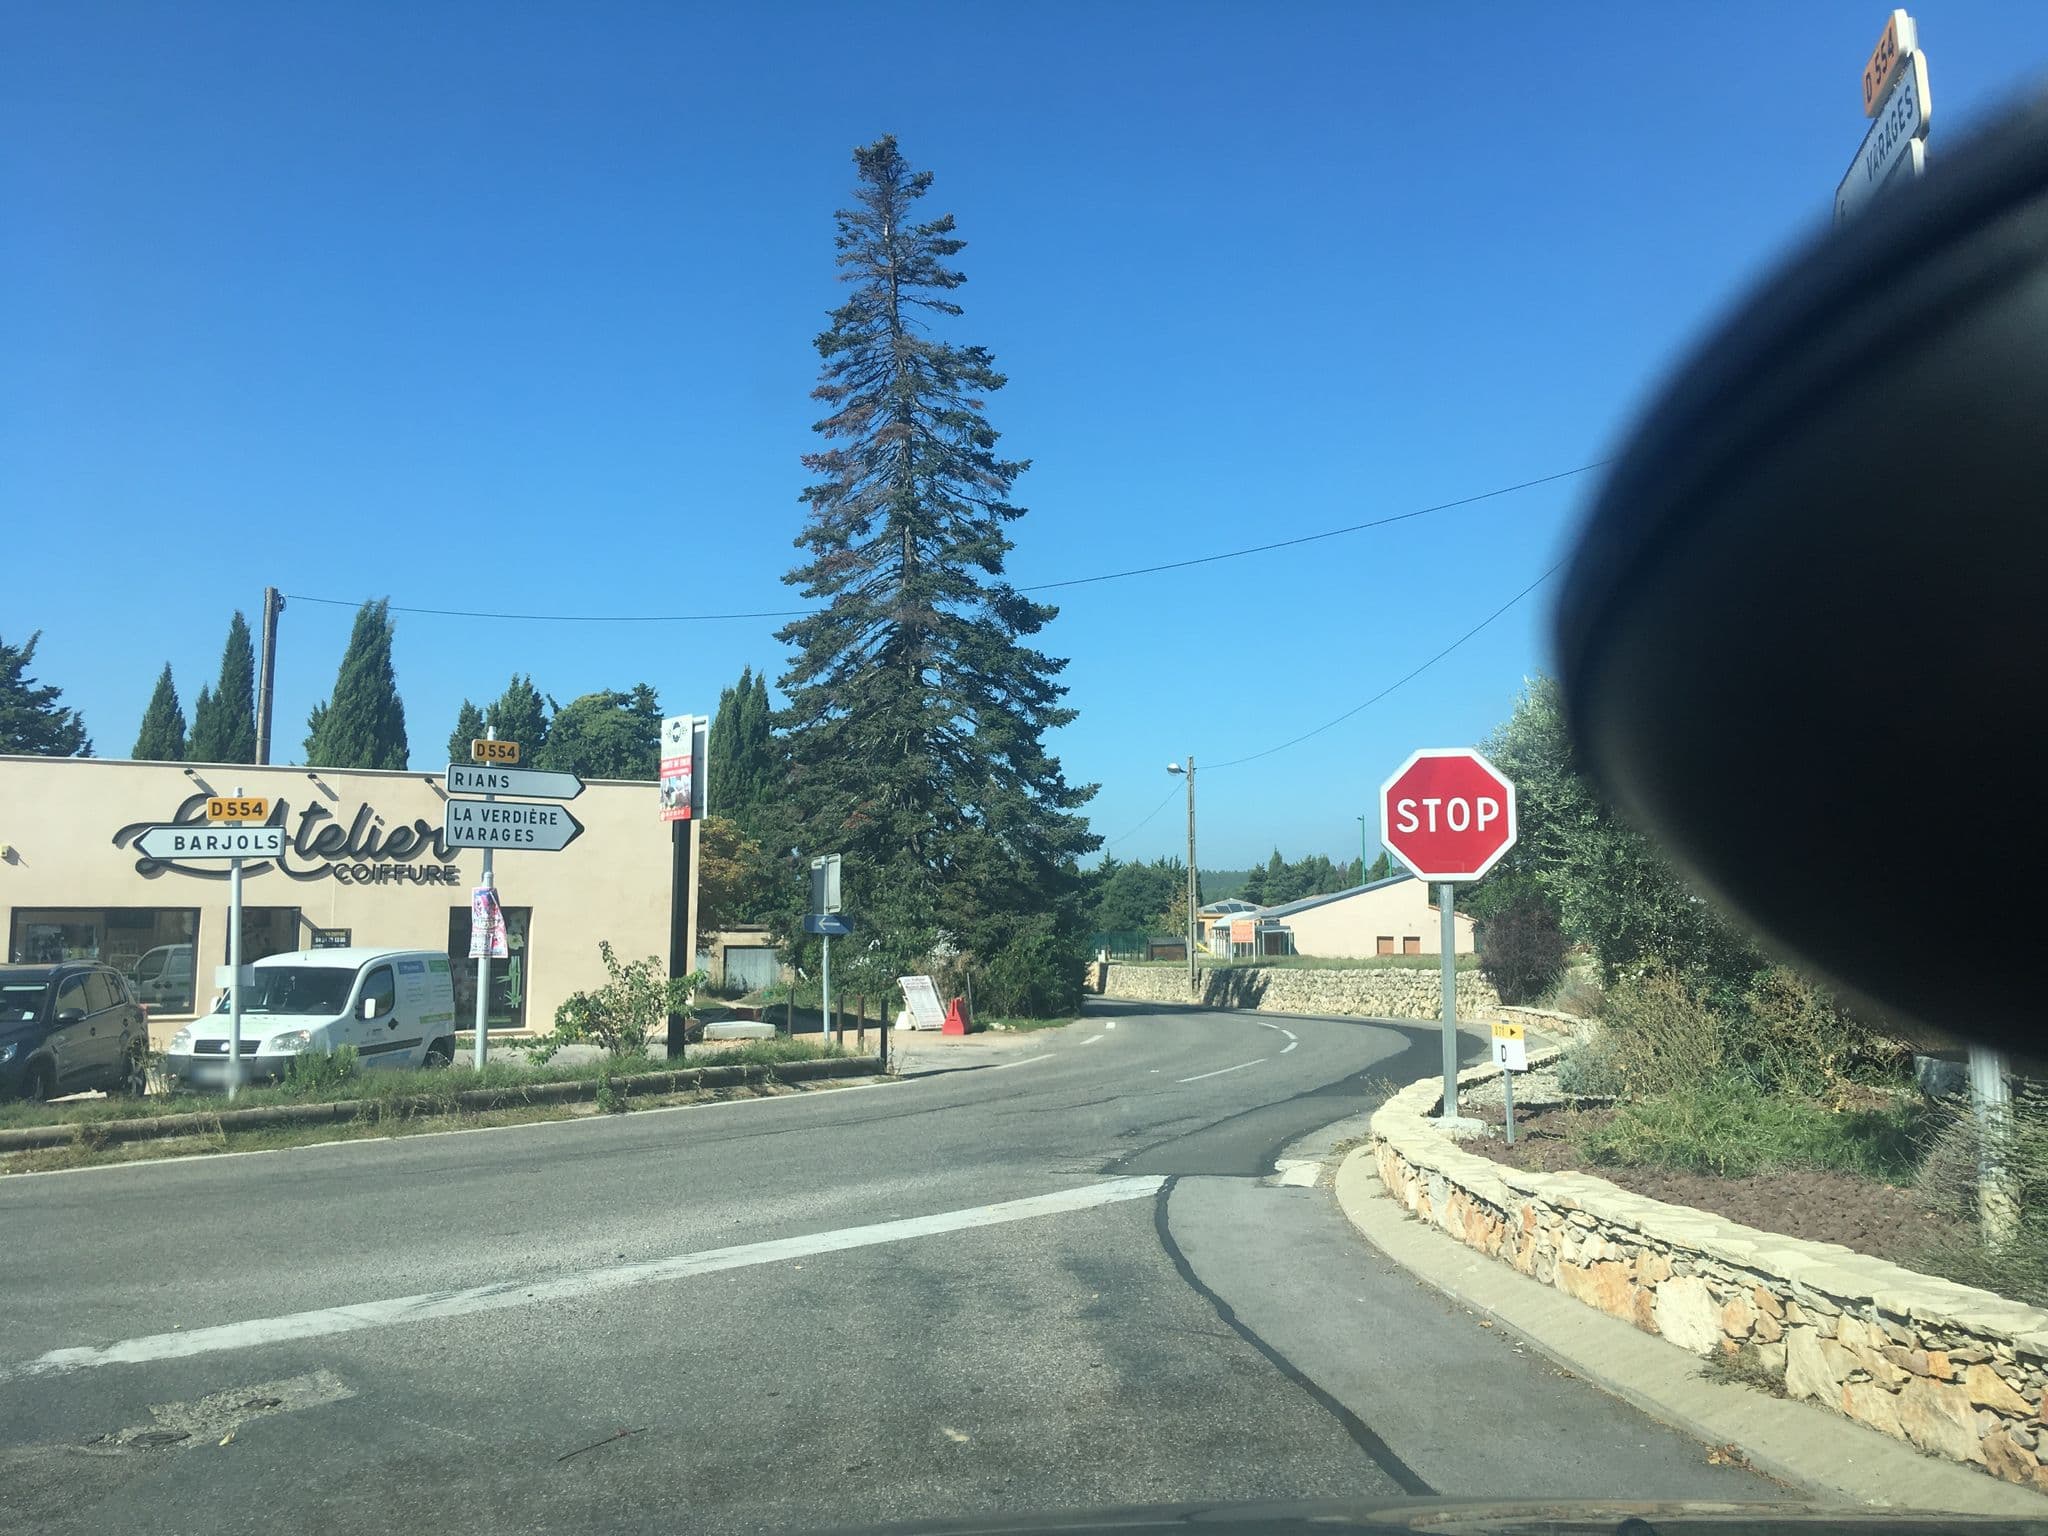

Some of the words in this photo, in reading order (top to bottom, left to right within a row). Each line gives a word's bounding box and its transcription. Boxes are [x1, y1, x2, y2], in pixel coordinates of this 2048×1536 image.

[1866, 84, 1914, 182] VARAGES
[454, 772, 510, 788] RIANS
[453, 807, 472, 821] LA
[481, 808, 558, 826] VERDIÈRE
[1396, 796, 1500, 833] STOP
[174, 835, 279, 851] BARJOLS
[454, 826, 534, 843] VARAGES
[333, 863, 458, 885] COIFFURE
